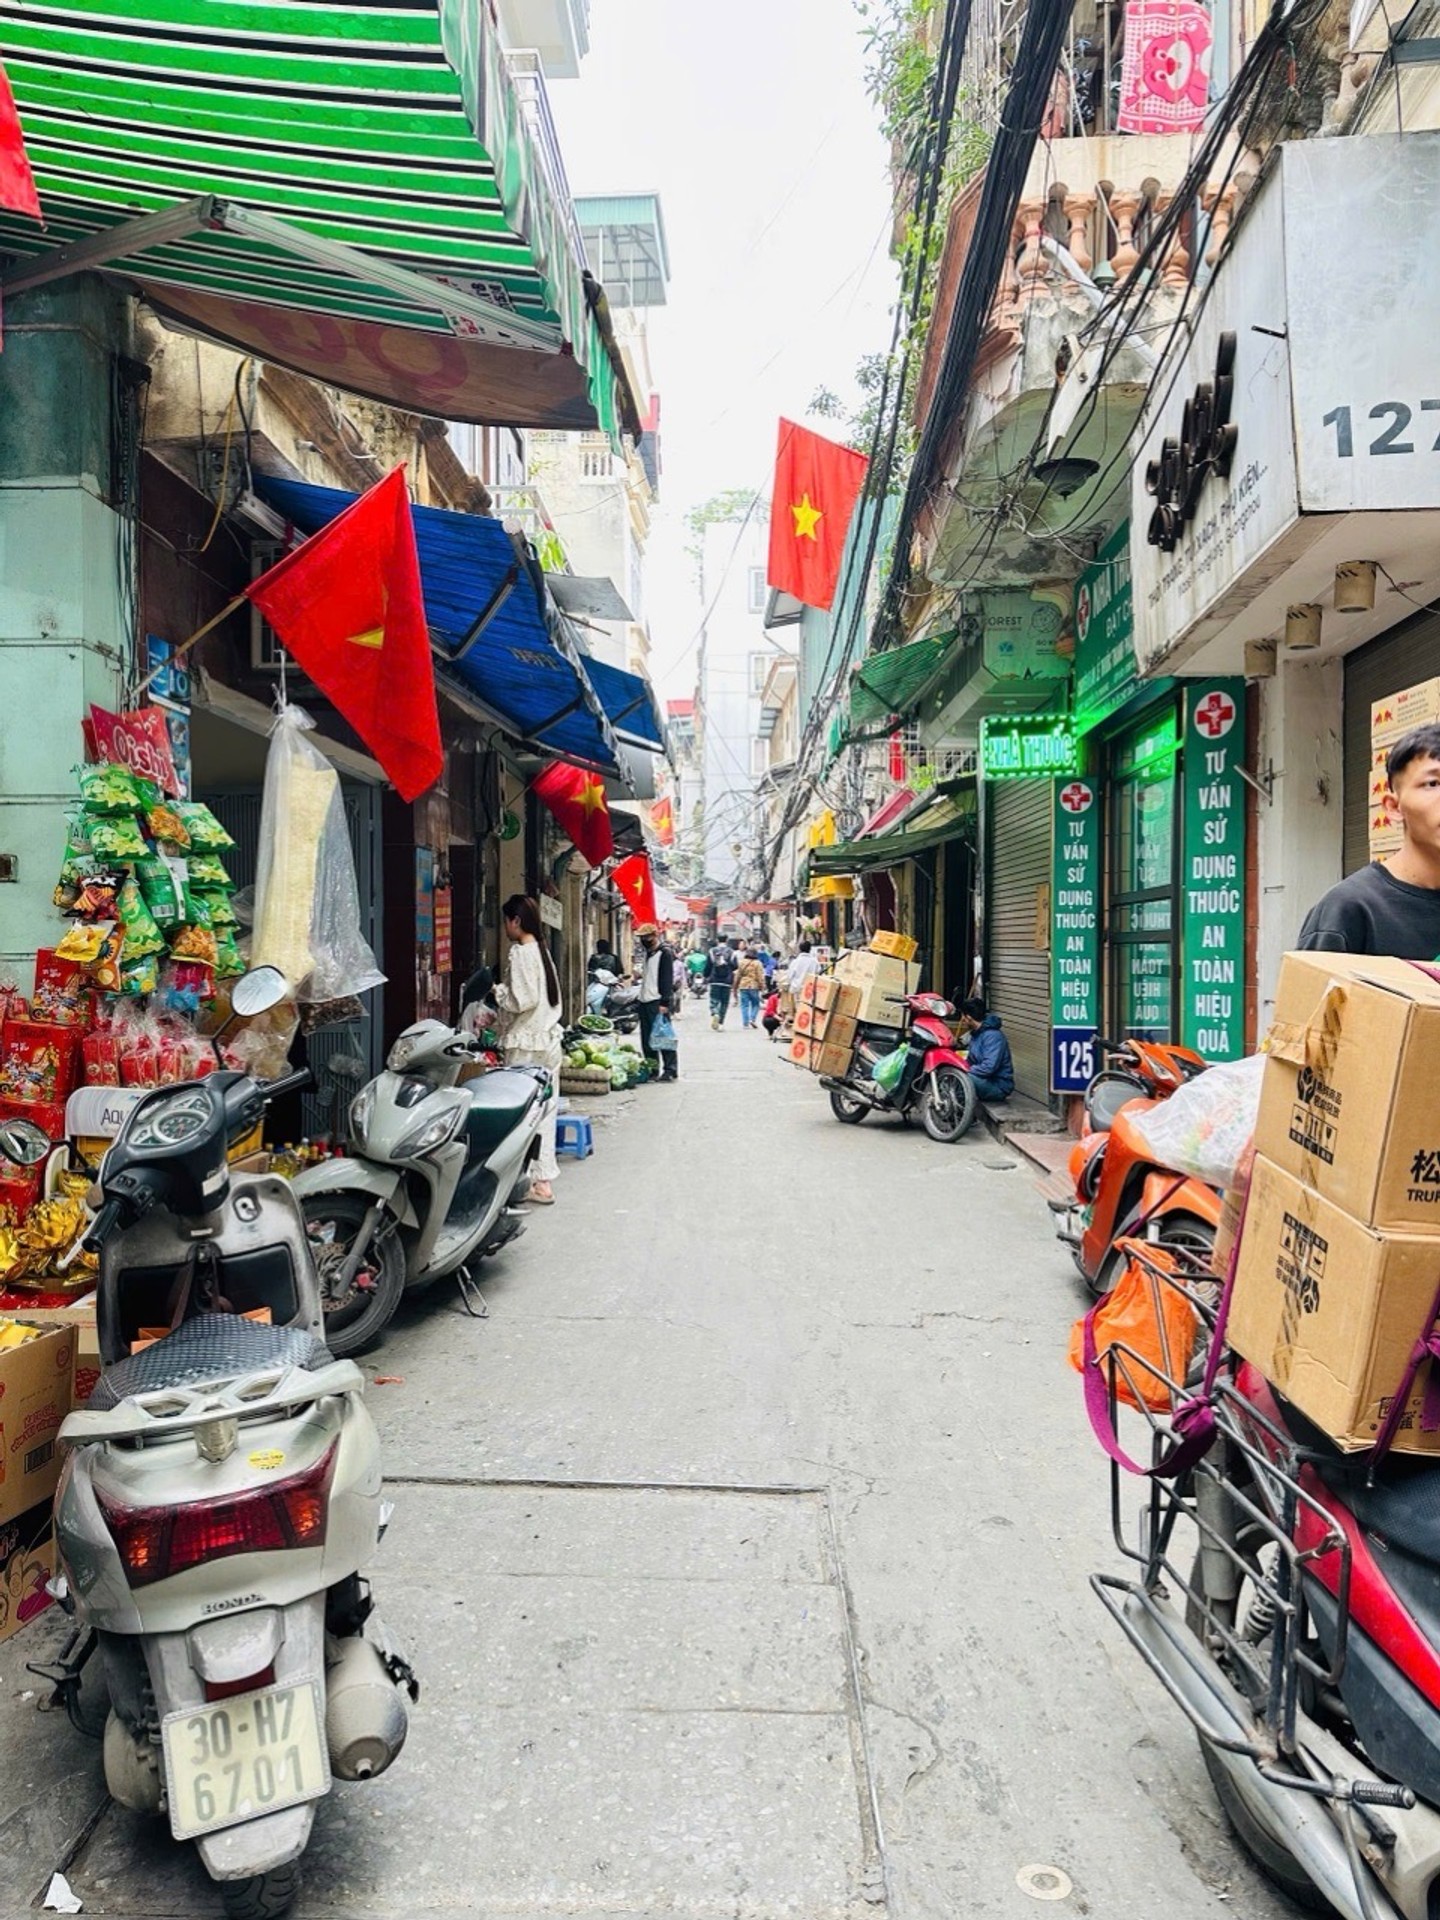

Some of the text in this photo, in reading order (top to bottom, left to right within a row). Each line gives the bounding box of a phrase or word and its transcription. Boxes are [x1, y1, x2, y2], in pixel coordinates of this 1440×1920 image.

[113, 725, 168, 780] Oishi
[988, 722, 1073, 769] NHÀ THUỐC
[1205, 748, 1227, 775] TƯ
[1199, 777, 1231, 810] VẤN
[1068, 820, 1086, 837] TƯ
[1203, 812, 1228, 844] SỬ
[1063, 839, 1089, 860] VẤN
[1067, 862, 1086, 883] SỬ
[1192, 854, 1236, 884] DỤNG
[1058, 889, 1093, 910] DỤNG
[1188, 881, 1240, 914] THUỐC
[1055, 907, 1095, 929] THUỐC
[1066, 936, 1084, 952] AN
[1202, 925, 1225, 948] AN
[1059, 955, 1091, 975] TOÀN
[1192, 955, 1235, 984] TOÀN
[1061, 978, 1090, 1000] HIỆU
[1062, 999, 1088, 1021] QUẢ
[1195, 990, 1232, 1023] HIỆU
[1197, 1022, 1230, 1054] QUẢ
[1058, 1041, 1094, 1080] 125
[201, 1594, 266, 1616] HONDA
[187, 1690, 295, 1765] 30-H7
[193, 1745, 304, 1821] 6701
